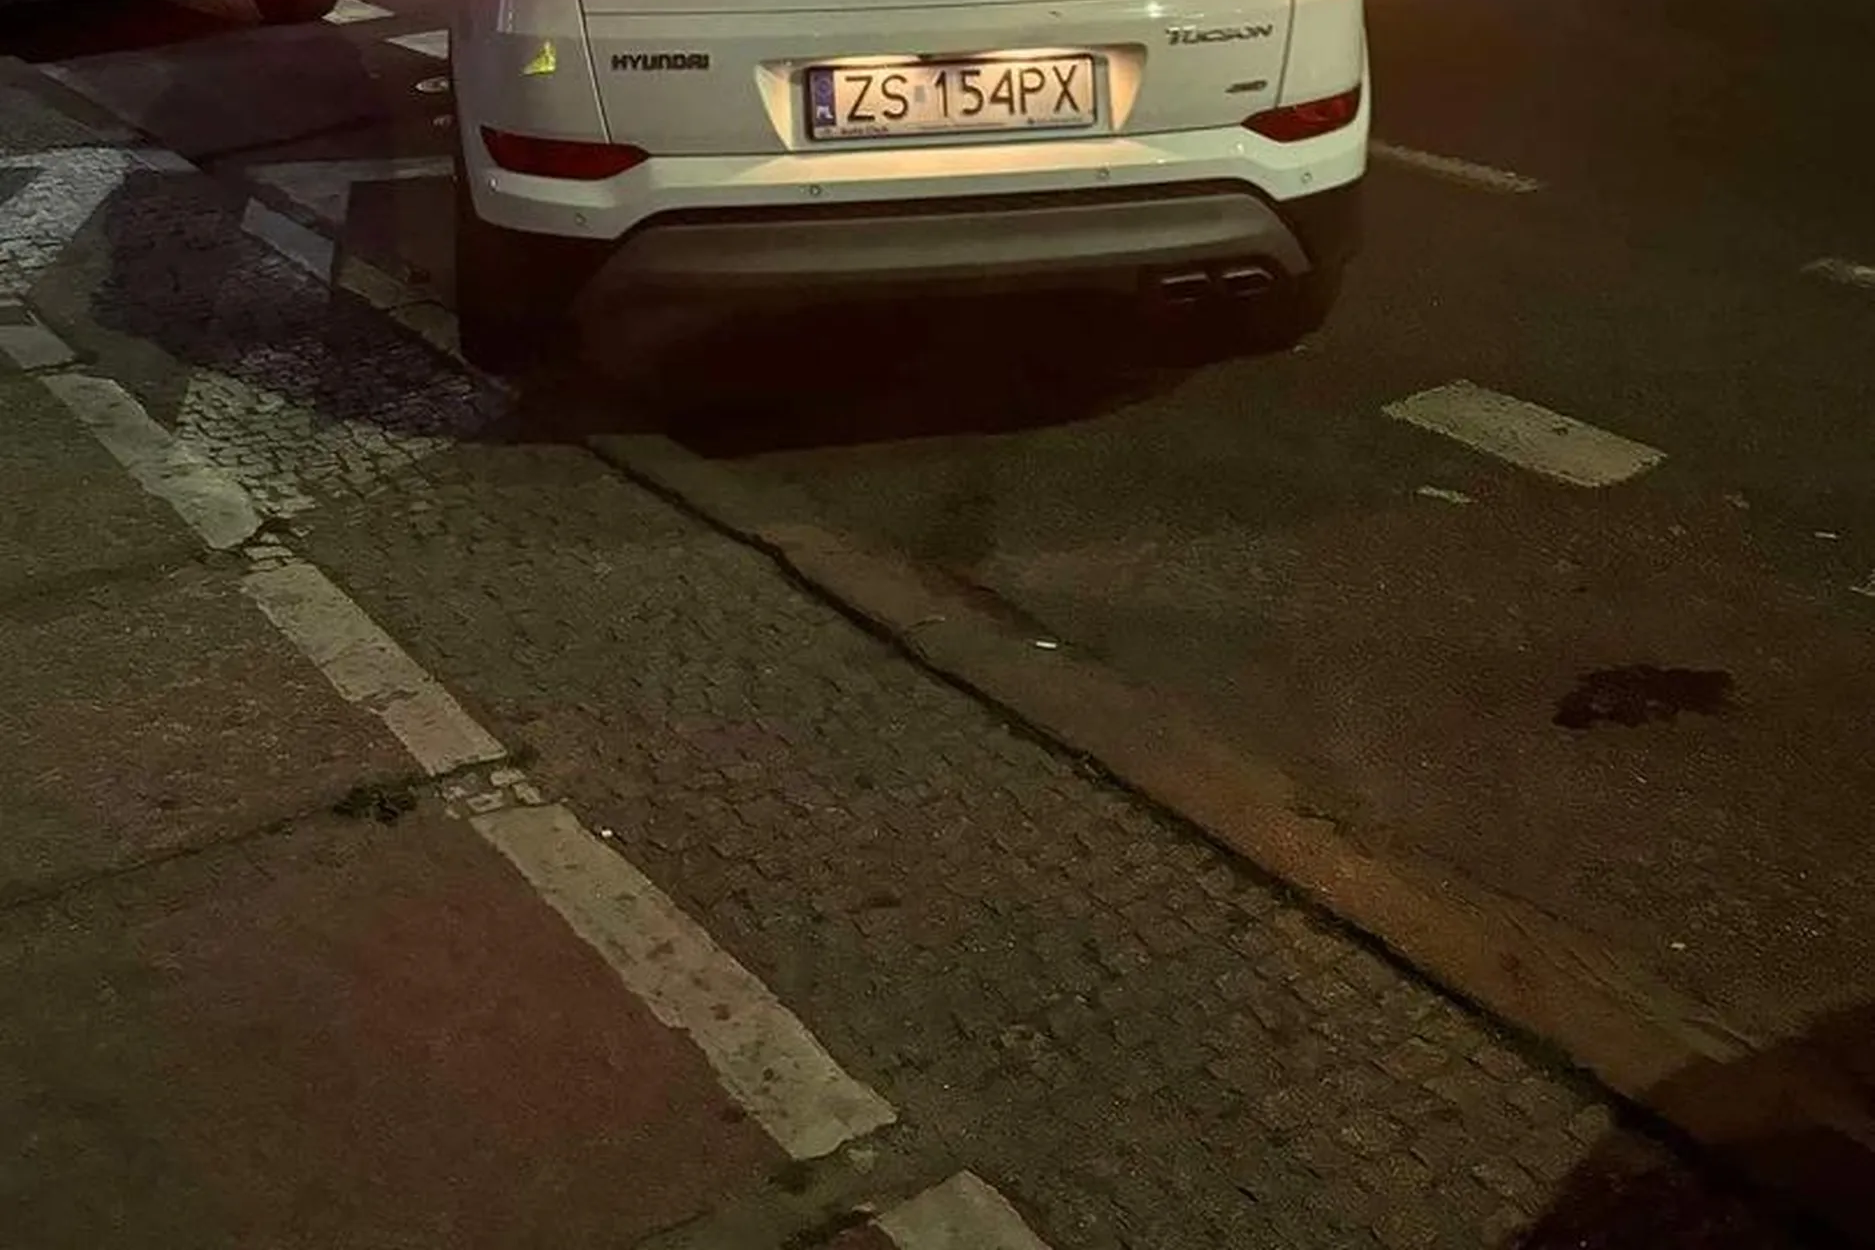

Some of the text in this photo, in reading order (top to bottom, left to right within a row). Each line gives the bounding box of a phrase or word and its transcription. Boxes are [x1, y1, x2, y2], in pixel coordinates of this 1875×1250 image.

[1164, 24, 1273, 46] TUCSON
[611, 53, 710, 71] HYUNDAI
[844, 64, 1081, 122] ZS 154PX
